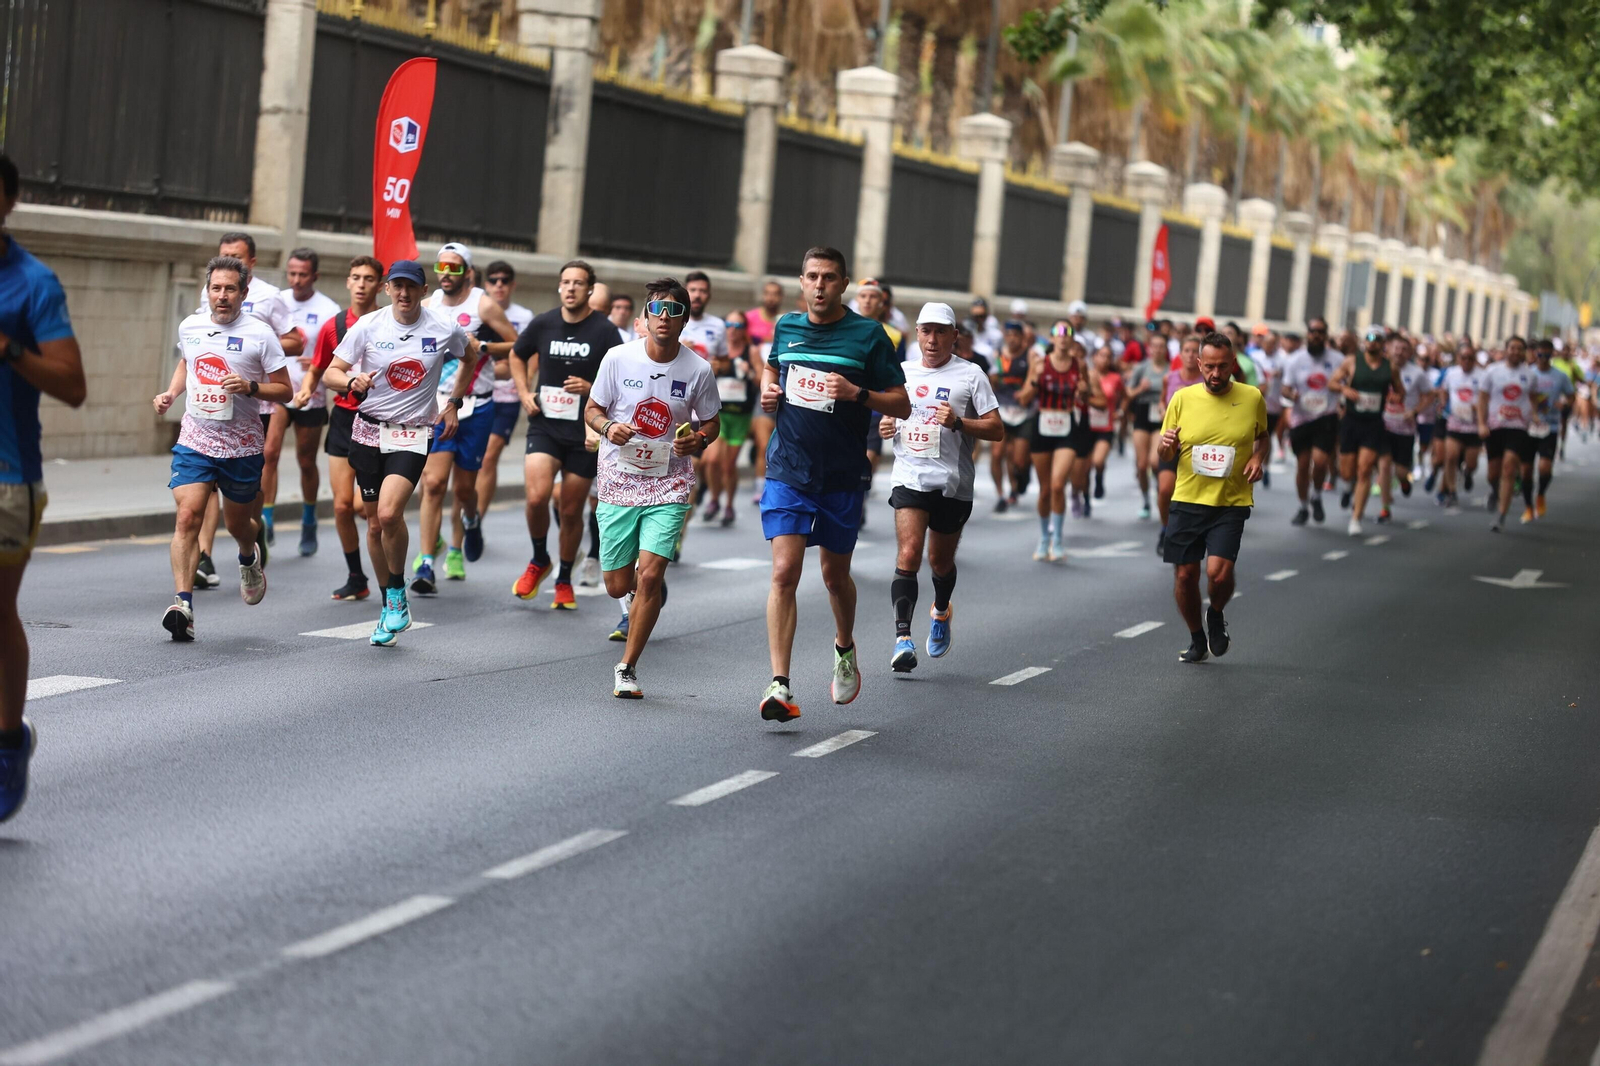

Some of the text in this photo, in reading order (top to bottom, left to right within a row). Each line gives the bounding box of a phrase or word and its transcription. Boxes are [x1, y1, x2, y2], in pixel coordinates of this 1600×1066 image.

[383, 176, 410, 203] 50
[549, 340, 590, 357] HWPO
[199, 360, 226, 376] PONLE
[394, 365, 421, 379] PONLE
[391, 372, 418, 384] FRENO
[797, 377, 825, 392] 495
[195, 393, 227, 403] 1269
[640, 406, 668, 424] PONLE
[637, 414, 665, 431] FRENO
[391, 430, 417, 439] 647
[908, 432, 929, 442] 175
[635, 448, 653, 460] 77
[1201, 452, 1225, 462] 842
